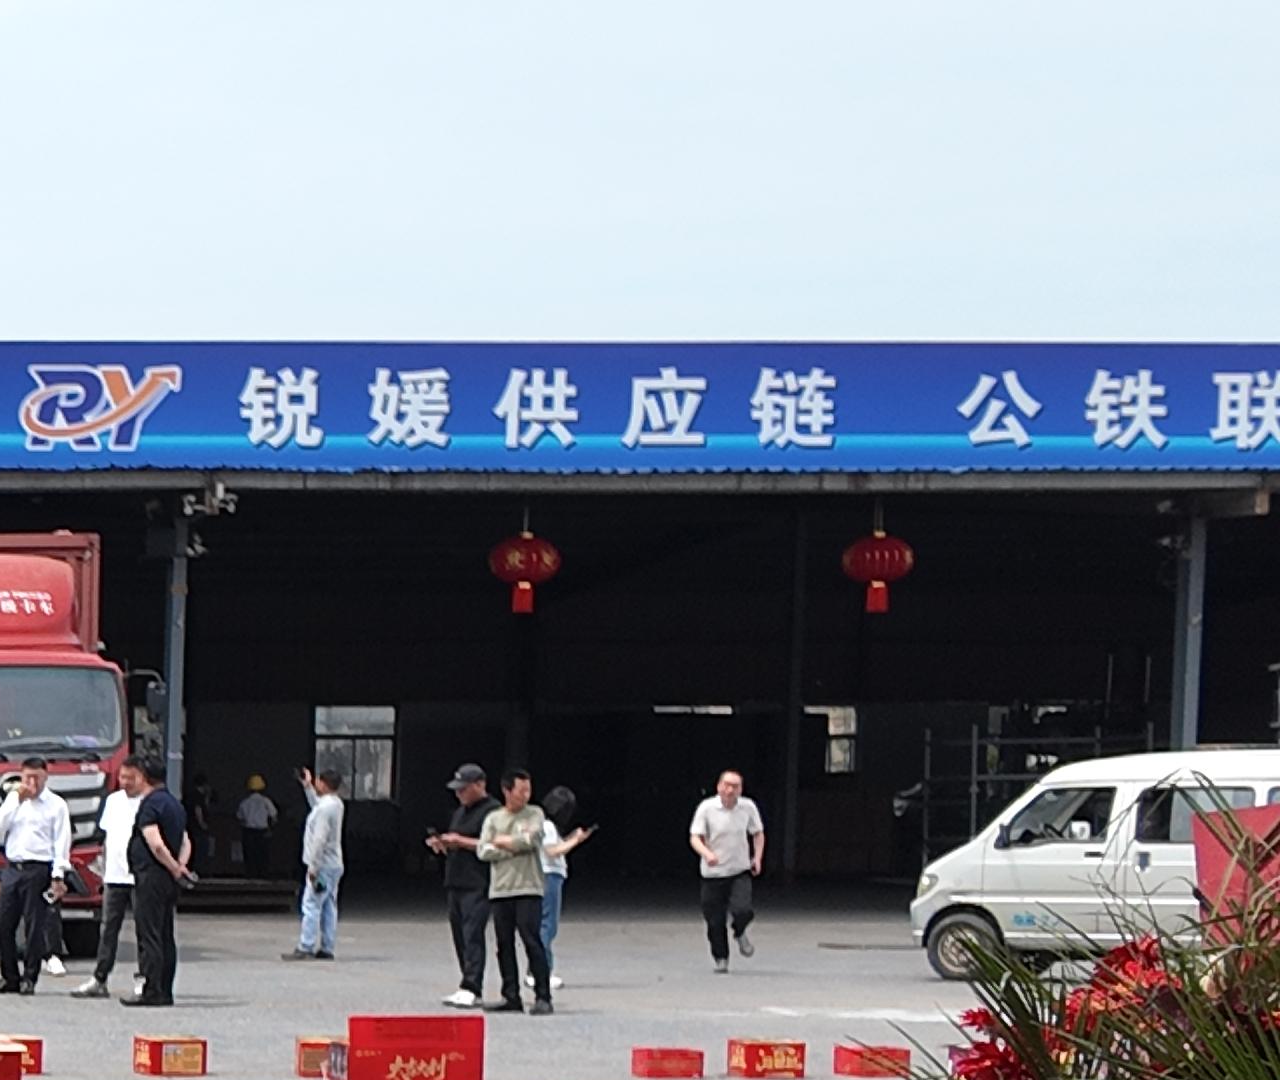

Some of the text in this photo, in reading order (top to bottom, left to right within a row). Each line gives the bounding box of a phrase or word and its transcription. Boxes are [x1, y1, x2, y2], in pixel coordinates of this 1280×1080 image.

[239, 366, 838, 450] 锐媛供应链
